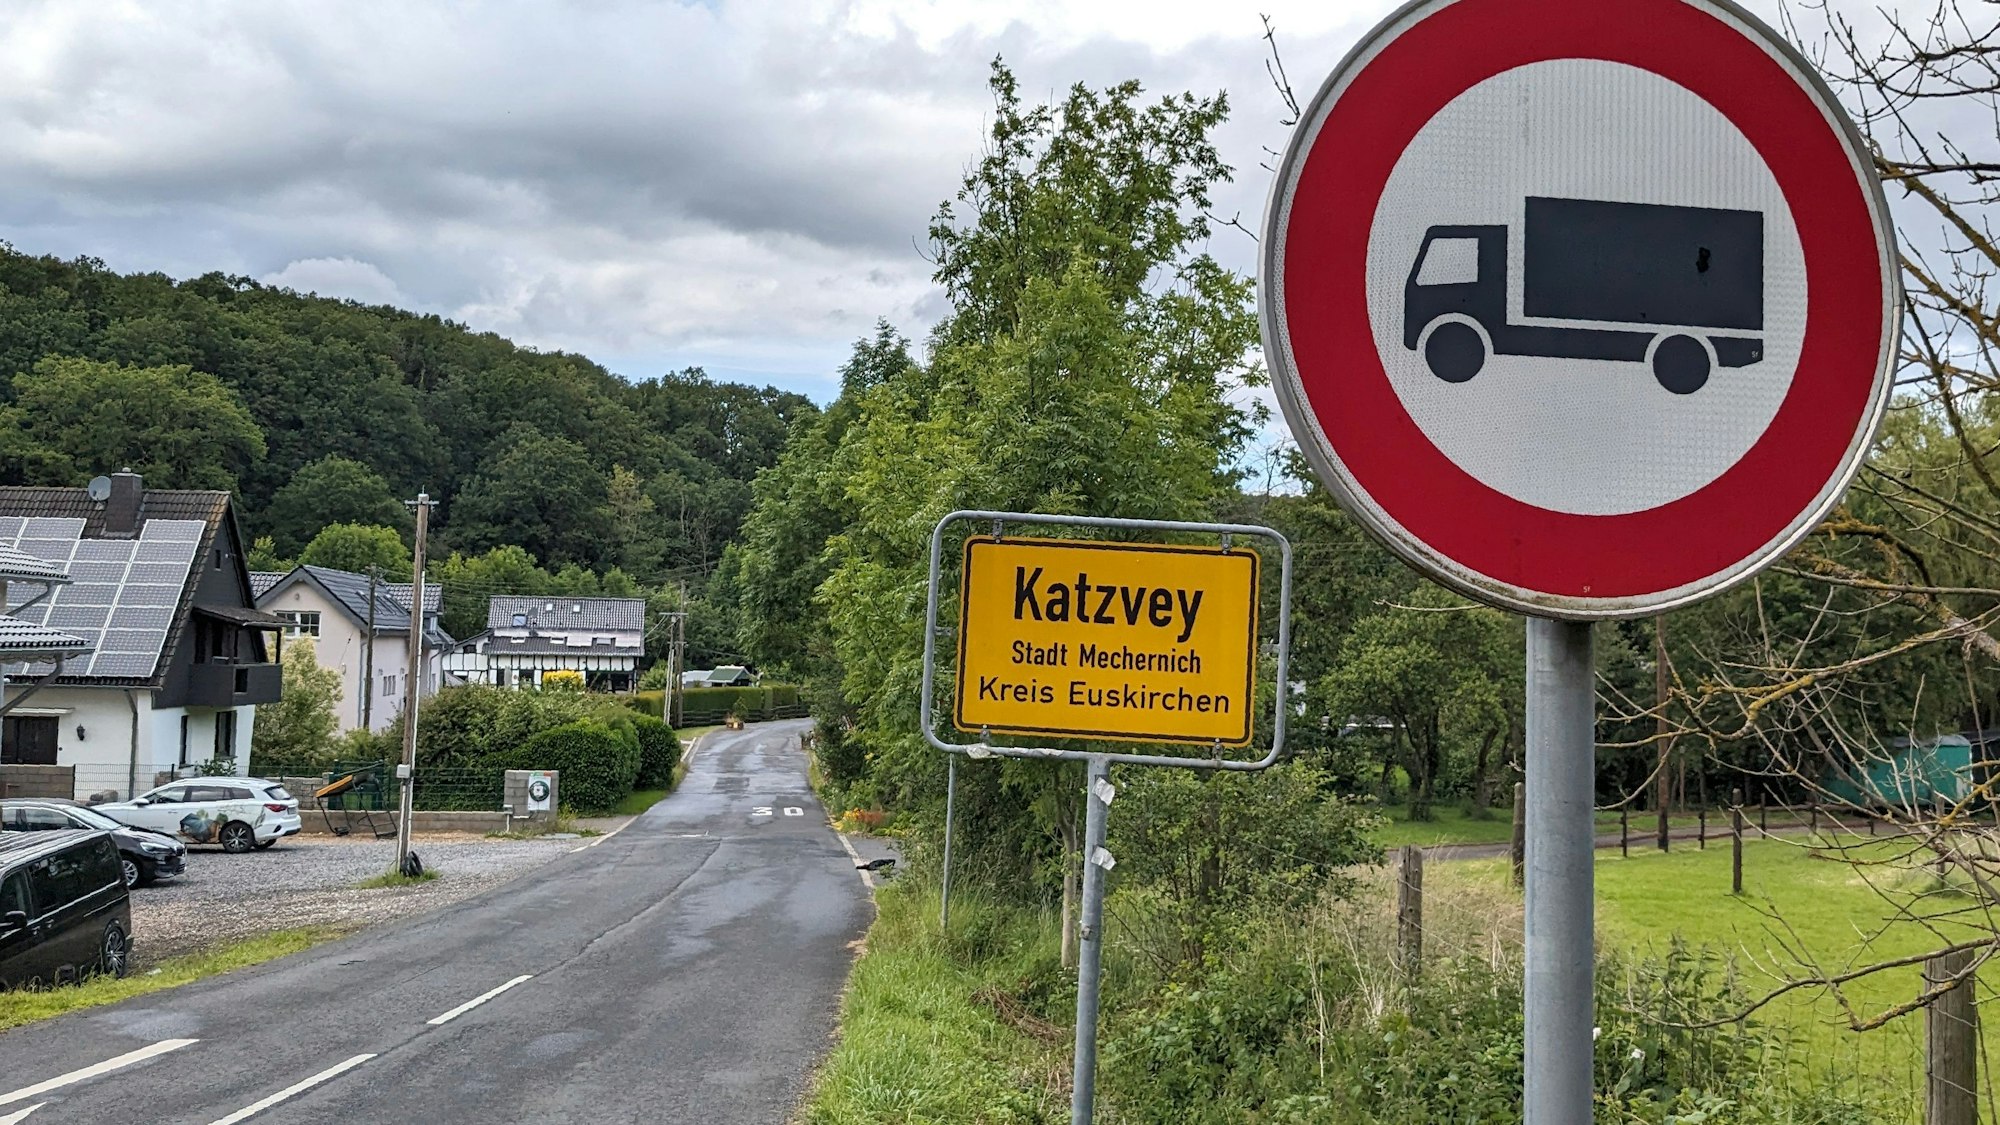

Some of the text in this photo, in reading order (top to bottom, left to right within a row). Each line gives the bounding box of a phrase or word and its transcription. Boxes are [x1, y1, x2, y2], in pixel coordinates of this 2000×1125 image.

[1013, 566, 1203, 643] Katzvey
[1012, 640, 1200, 674] Stadt Mechernich
[979, 676, 1229, 713] Kreis Euskirchen
[751, 806, 804, 816] 30
